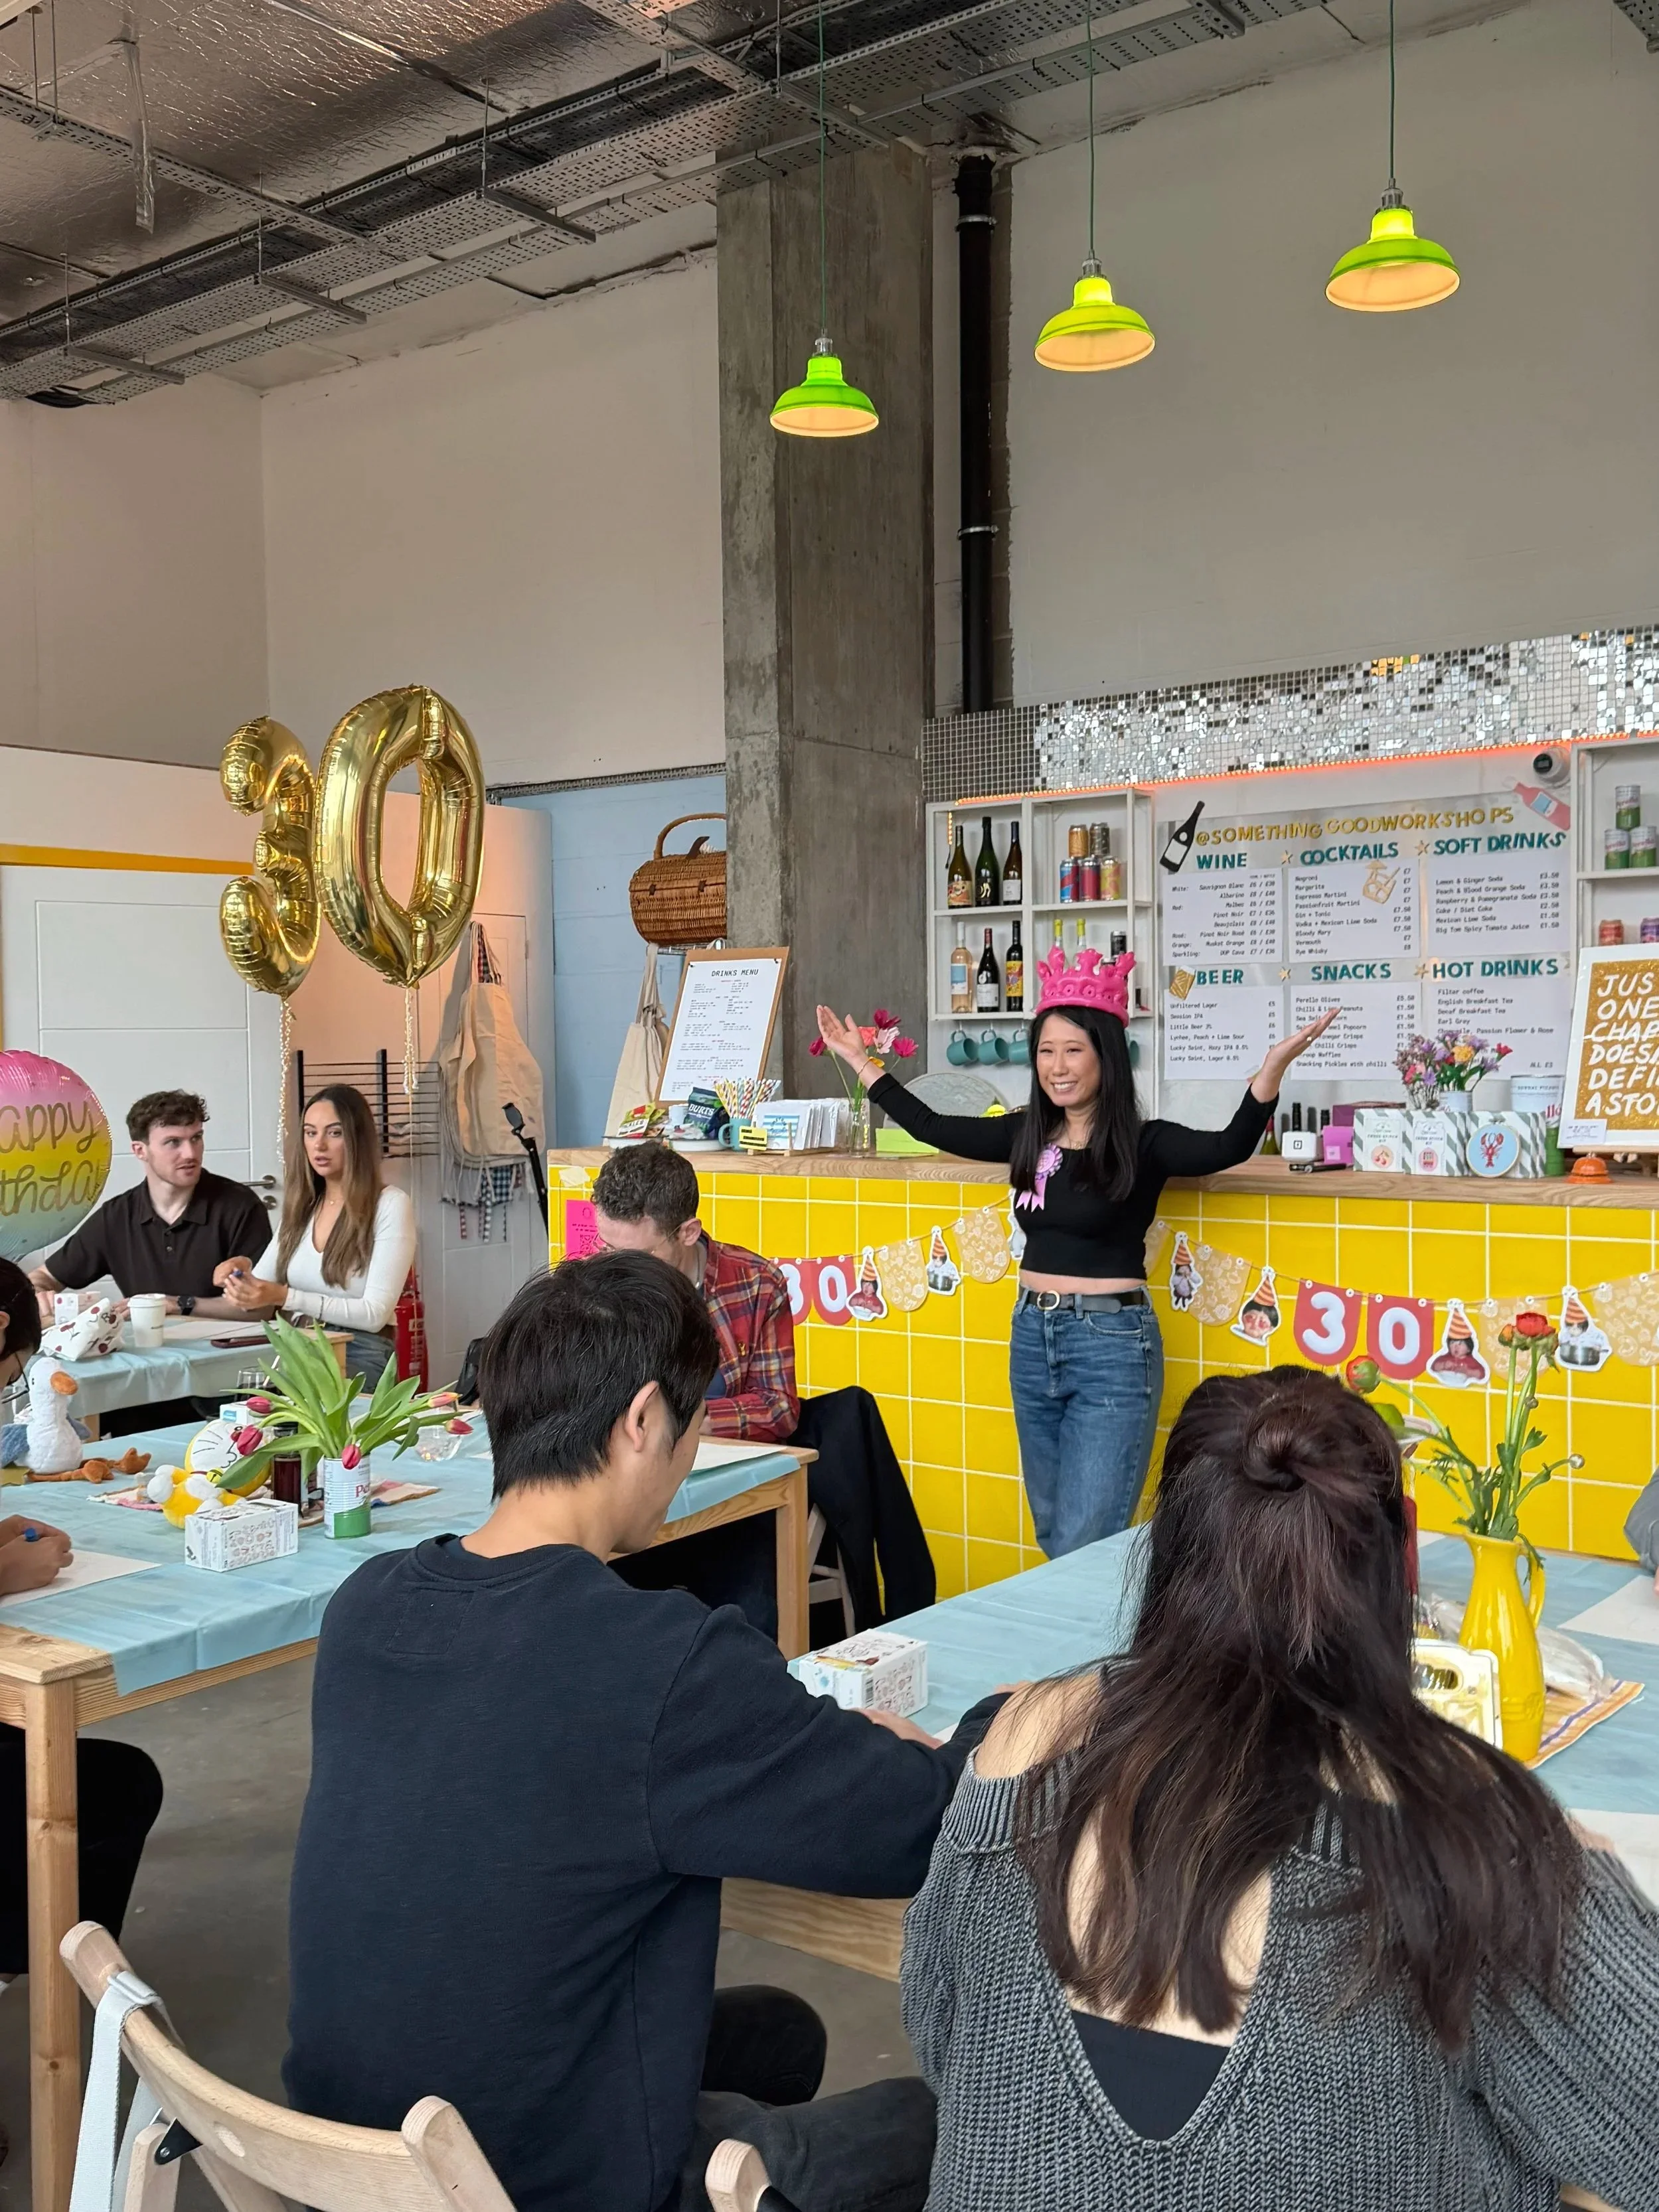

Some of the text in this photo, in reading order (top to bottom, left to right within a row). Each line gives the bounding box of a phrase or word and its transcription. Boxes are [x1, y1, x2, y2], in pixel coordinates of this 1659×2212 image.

[219, 684, 485, 1001] 30
[1300, 842, 1399, 865] COCKTAILS
[1434, 832, 1566, 855] SOFT DRINKS
[1197, 853, 1247, 869] WINE
[1197, 969, 1243, 985] BEER
[1311, 962, 1391, 981] SNACKS
[1433, 958, 1559, 979] HOT DRINKS
[1597, 972, 1654, 997] JUS
[1597, 996, 1659, 1019] ONE
[1591, 1020, 1659, 1045] CHAP
[1588, 1065, 1659, 1090] DEFI
[688, 1103, 714, 1116] BURTS
[1605, 1092, 1659, 1116] STO
[0, 1102, 99, 1153] appy
[1302, 1290, 1421, 1365] 30
